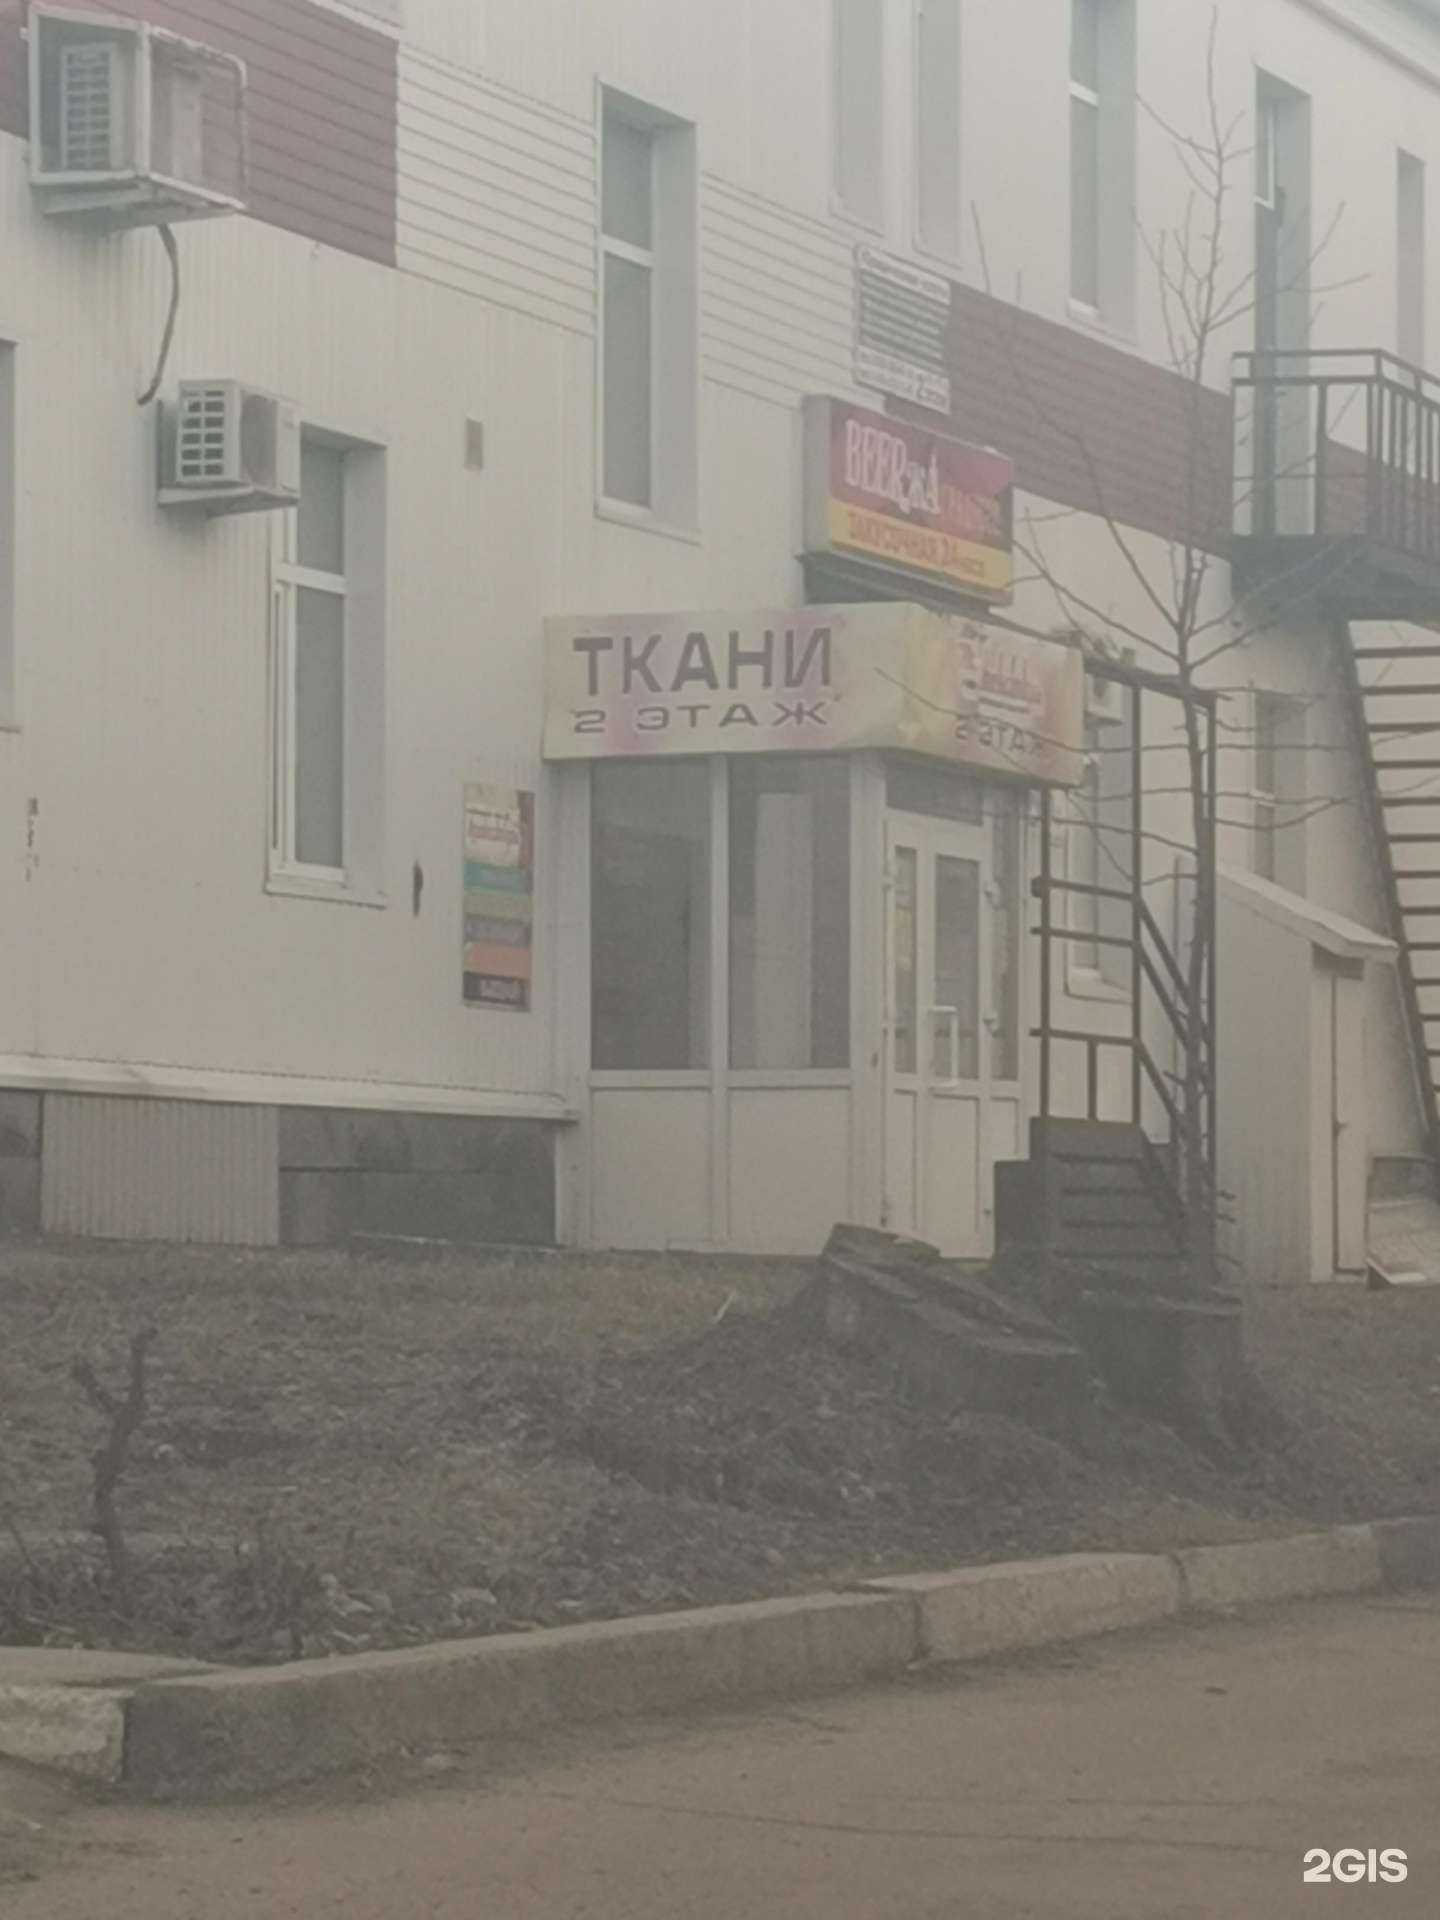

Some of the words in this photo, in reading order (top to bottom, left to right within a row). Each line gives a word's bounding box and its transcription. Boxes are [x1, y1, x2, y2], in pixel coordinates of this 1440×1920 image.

[573, 627, 832, 696] ТКАНИ
[573, 711, 606, 734] 2
[638, 702, 828, 731] ЭТАЖ
